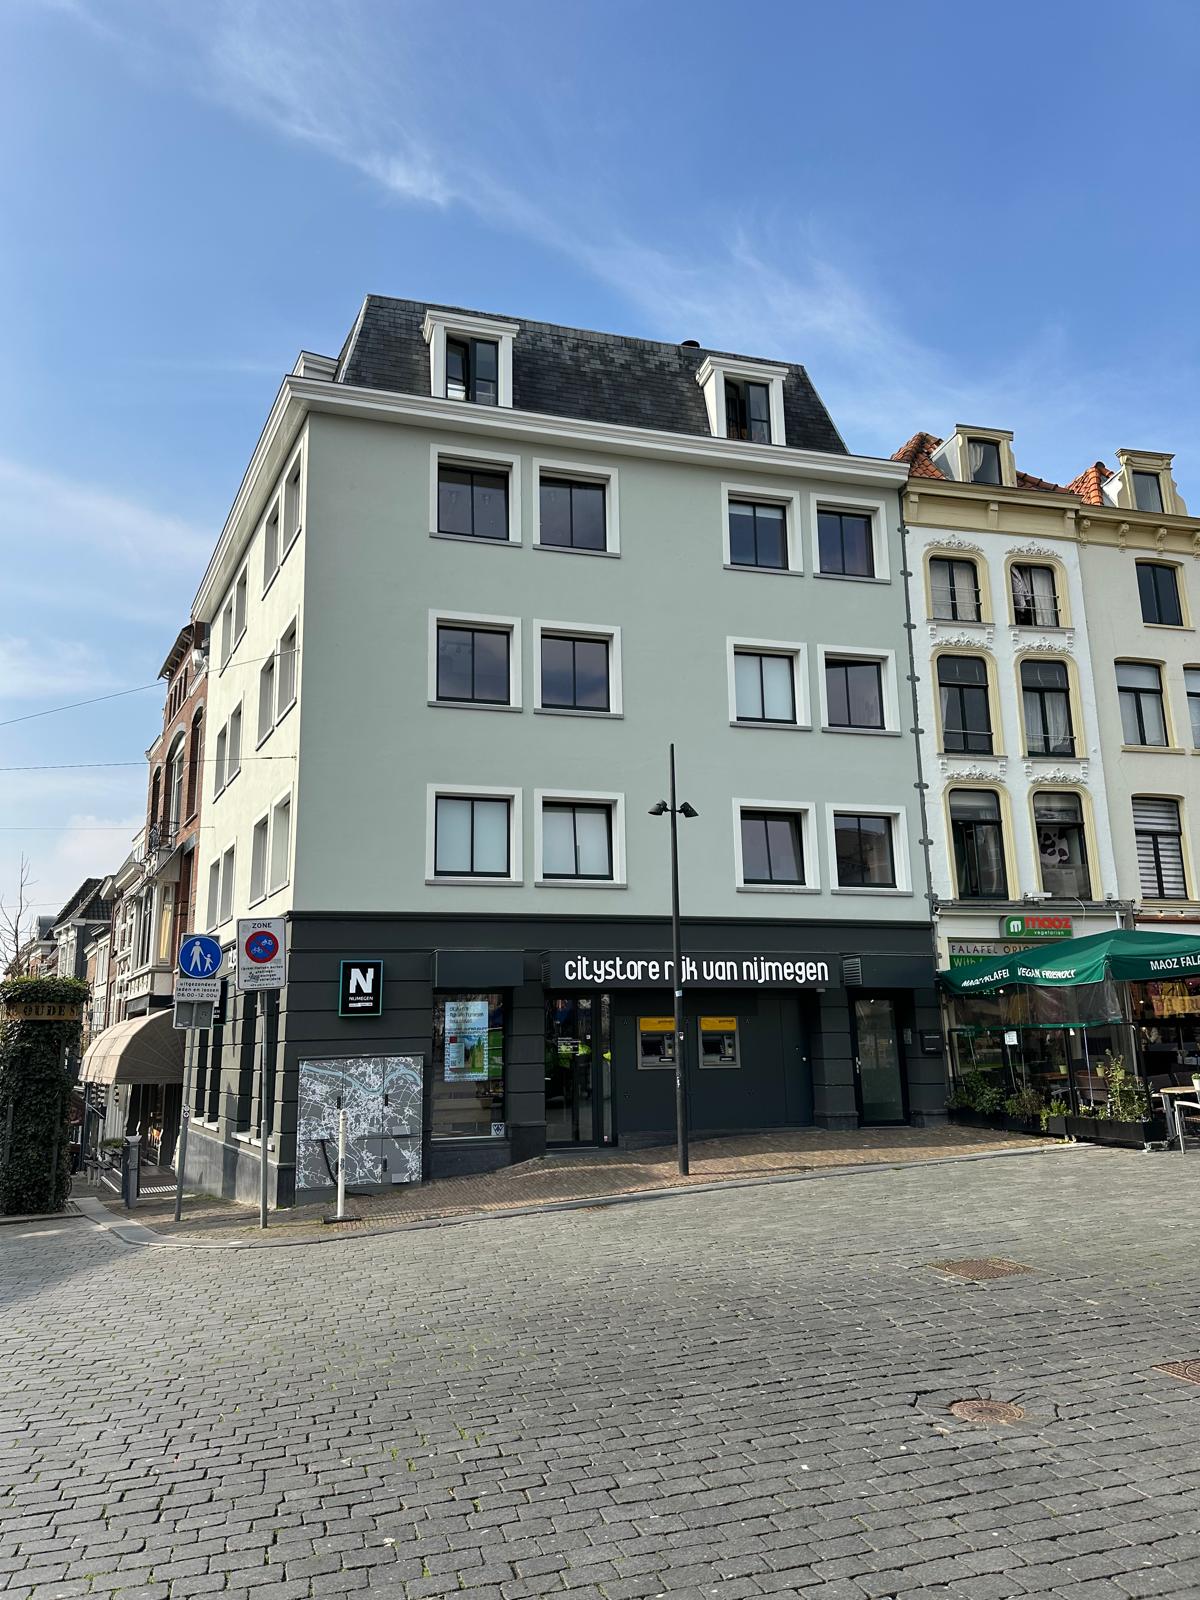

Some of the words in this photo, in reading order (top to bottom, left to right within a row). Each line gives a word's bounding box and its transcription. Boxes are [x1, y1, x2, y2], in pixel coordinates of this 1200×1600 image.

[1024, 916, 1072, 929] maoz
[951, 945, 998, 954] FALAFEL
[953, 957, 976, 968] With
[1149, 958, 1180, 971] MAOZ
[564, 955, 660, 984] citystore
[664, 955, 698, 983] rjk
[742, 956, 829, 984] nijmegen
[1017, 967, 1040, 979] VEGAN
[1041, 968, 1077, 979] FRIENDLY
[349, 967, 375, 994] N
